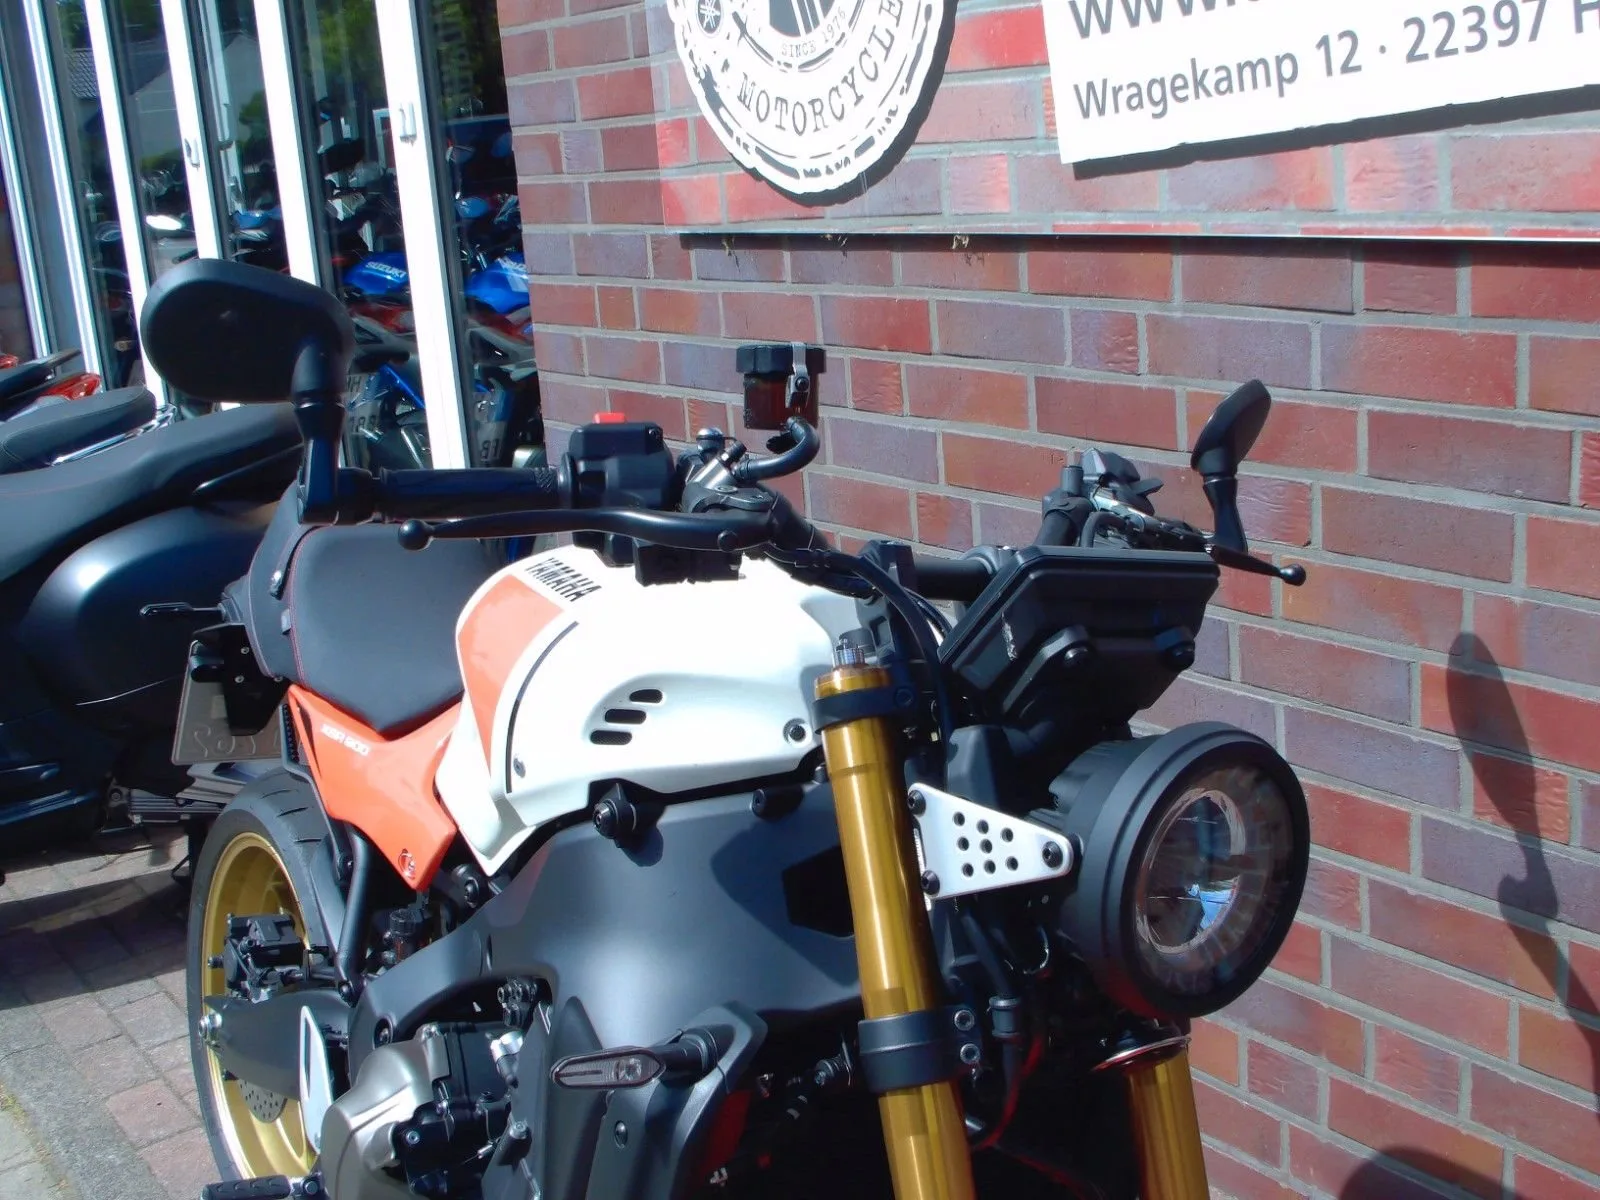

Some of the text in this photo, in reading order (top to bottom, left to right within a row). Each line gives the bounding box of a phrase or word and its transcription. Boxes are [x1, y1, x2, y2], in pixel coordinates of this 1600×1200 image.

[1073, 51, 1299, 119] Wragekamp
[1315, 29, 1362, 77] 12
[1403, 0, 1548, 63] 22397
[365, 261, 407, 278] SUZUKI
[524, 557, 602, 602] YAMAHA
